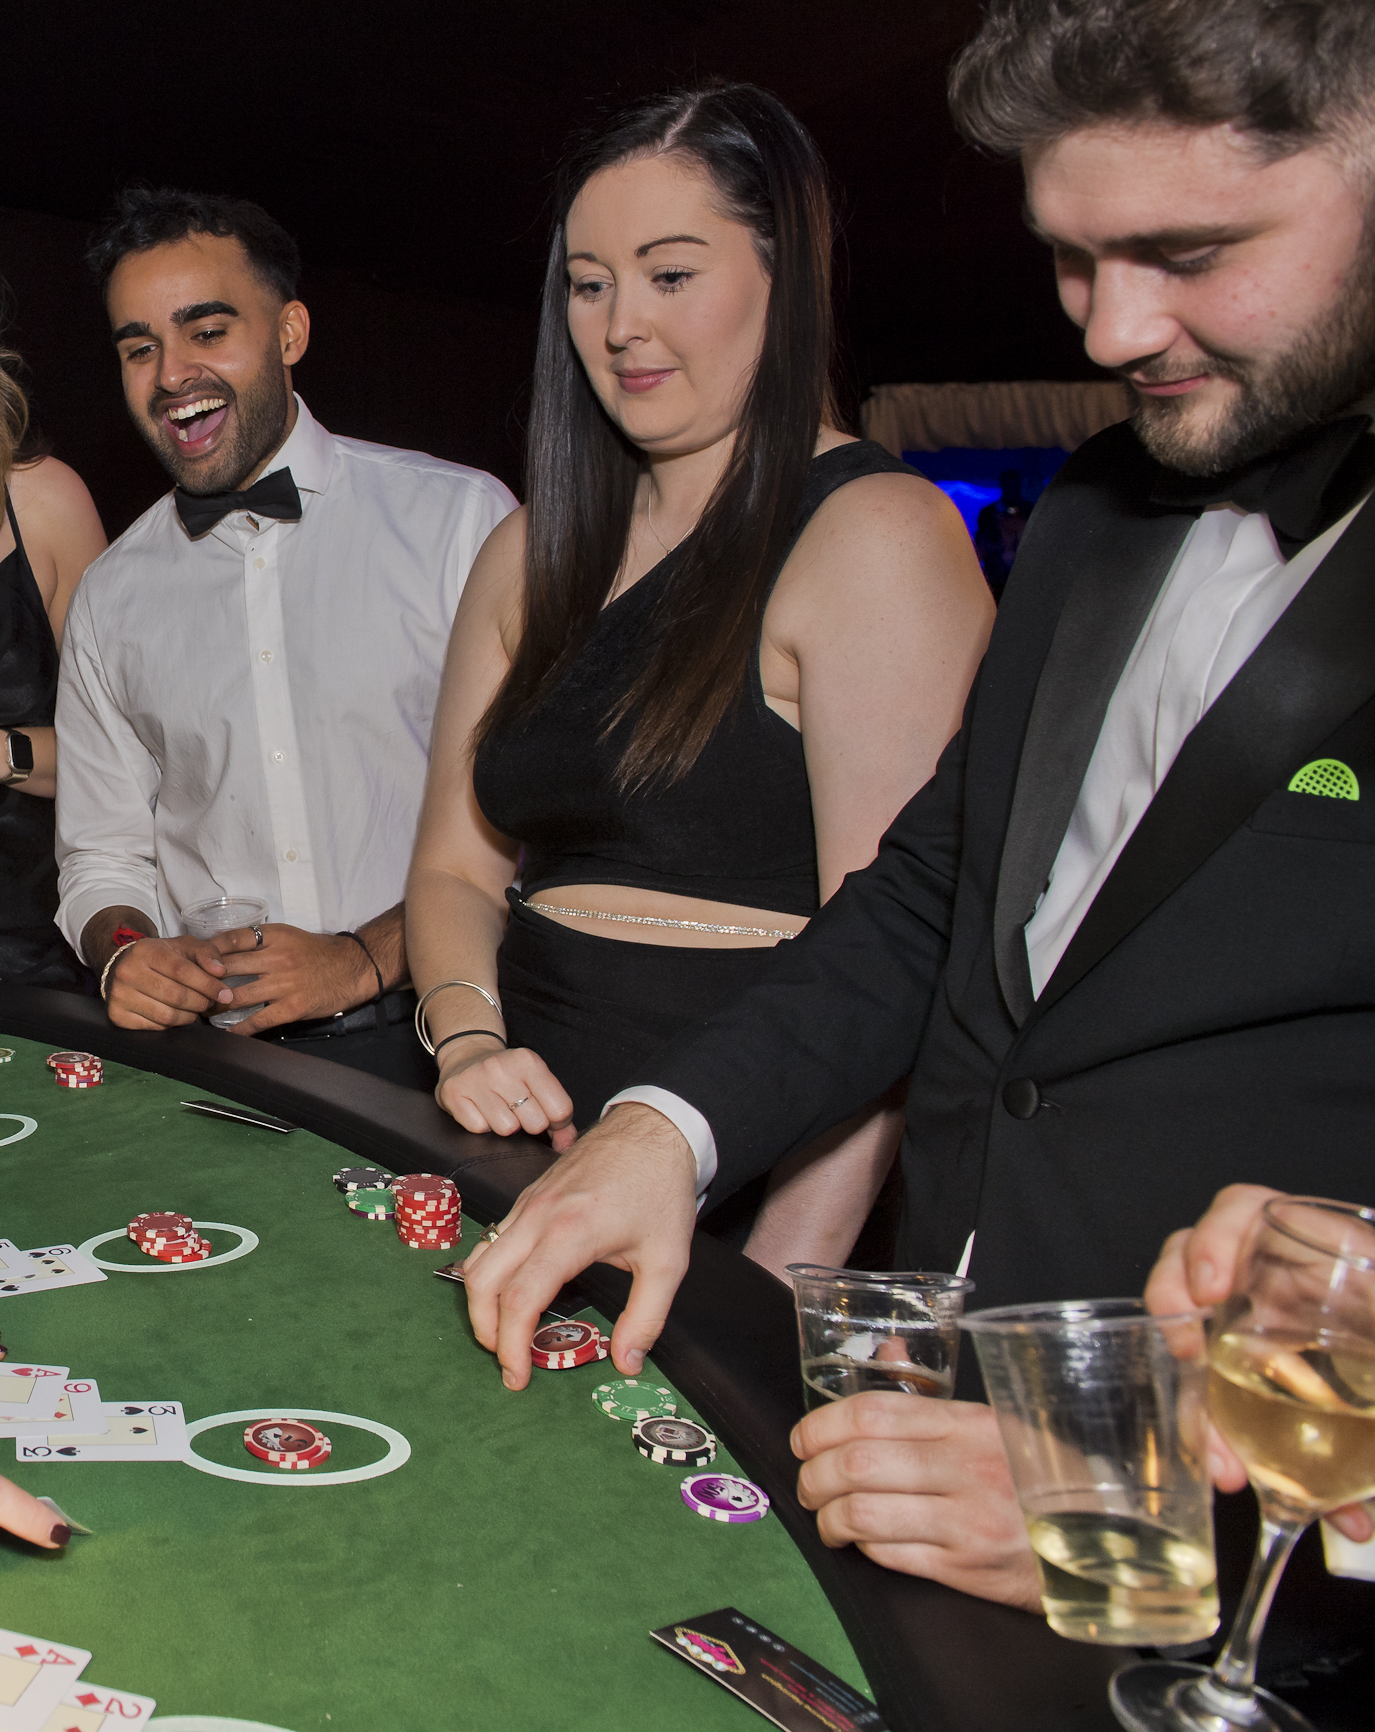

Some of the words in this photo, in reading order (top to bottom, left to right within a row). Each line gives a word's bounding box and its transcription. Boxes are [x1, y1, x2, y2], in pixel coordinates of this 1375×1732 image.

[48, 1247, 72, 1256] 6
[35, 1367, 62, 1378] A
[148, 1404, 176, 1415] 3
[22, 1446, 52, 1458] 3
[696, 1482, 725, 1500] 500
[40, 1648, 78, 1666] A
[103, 1697, 142, 1719] 2
